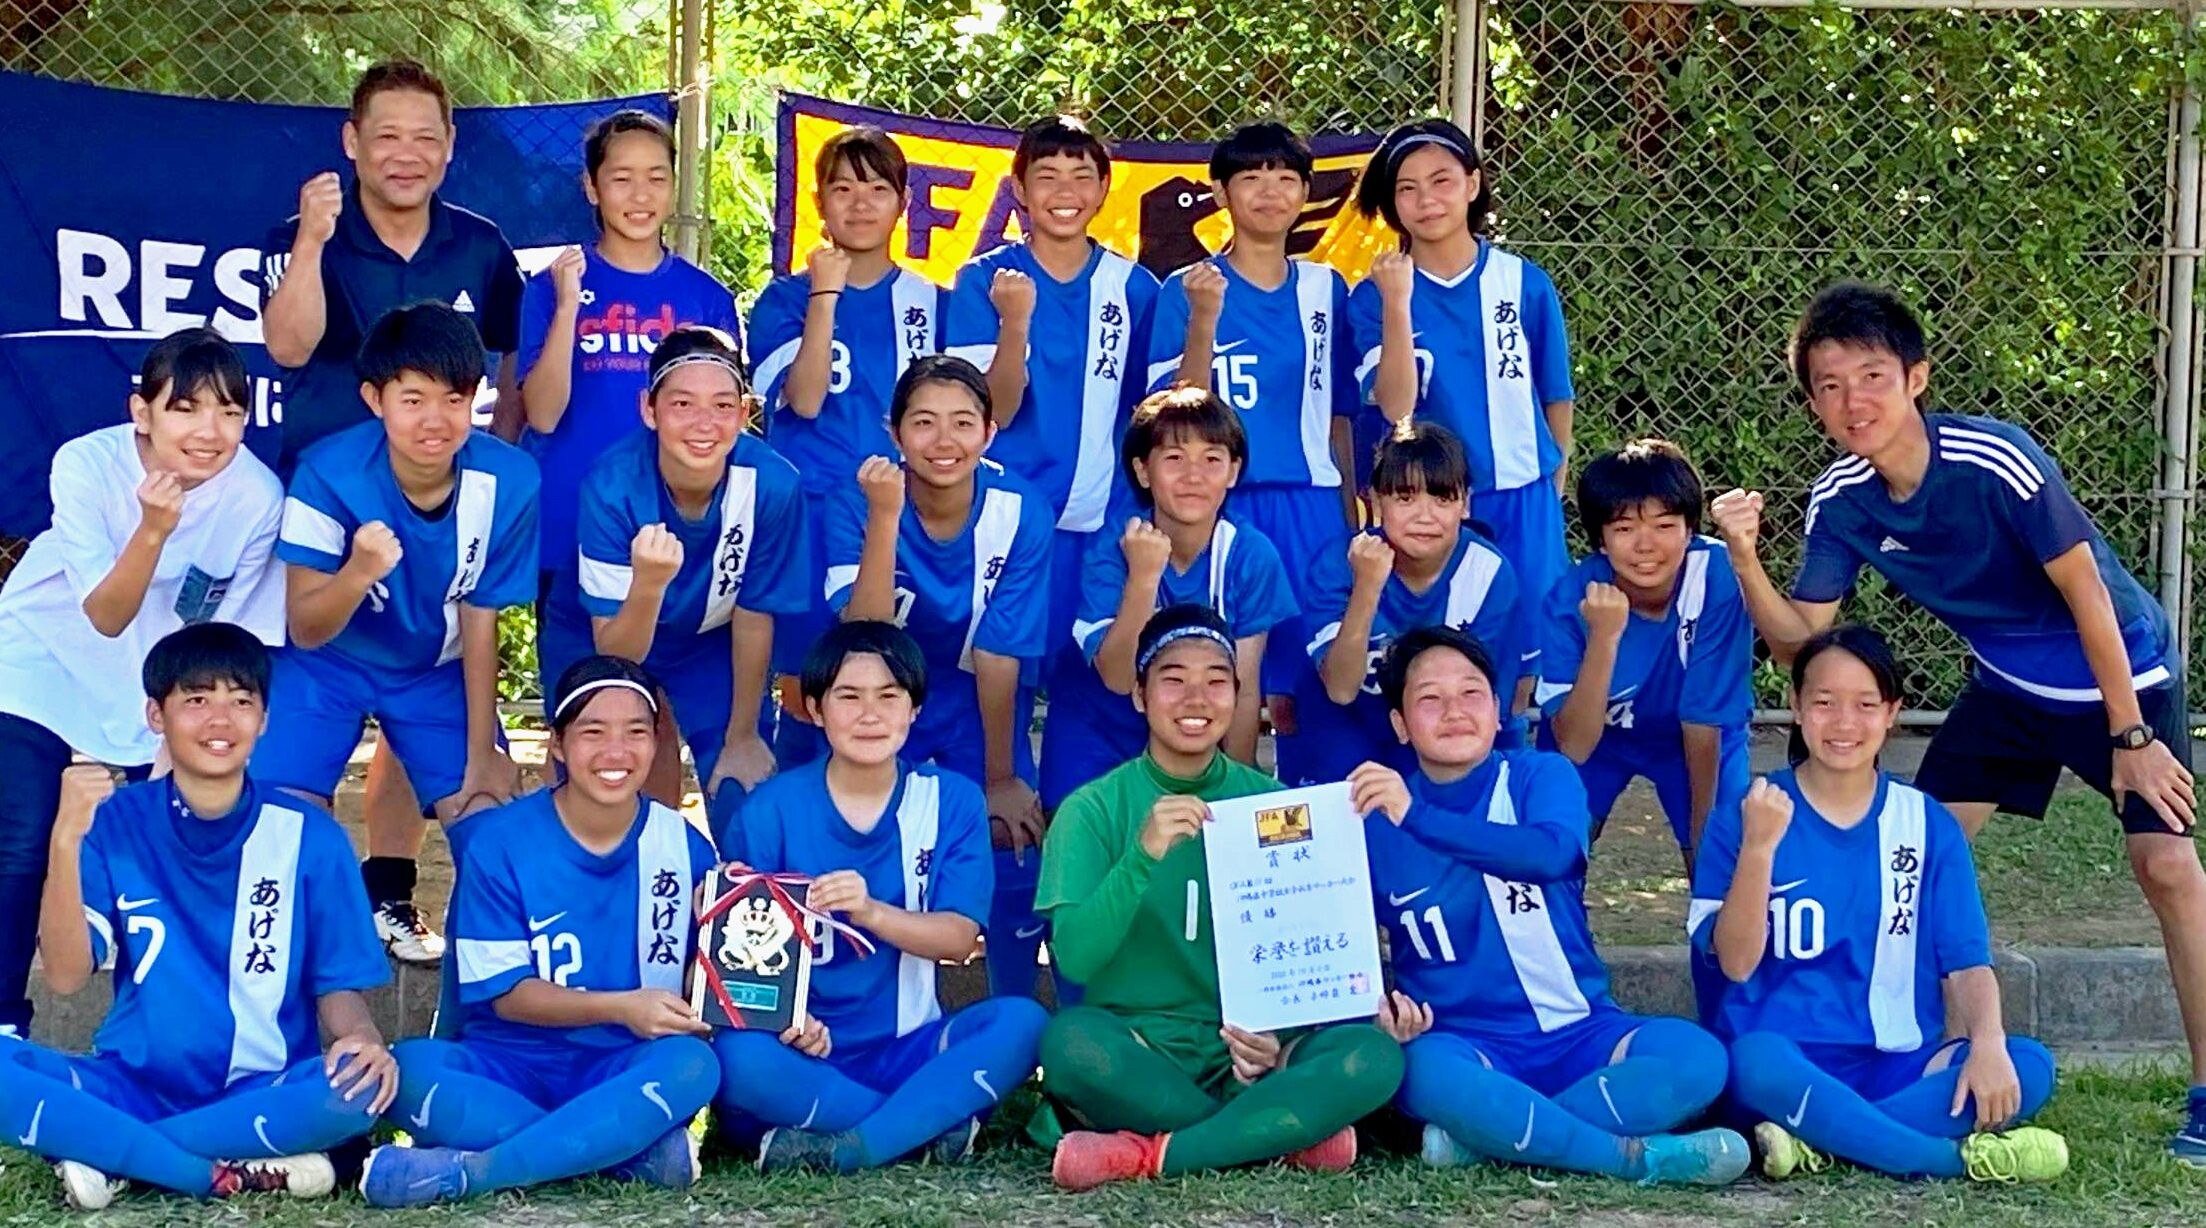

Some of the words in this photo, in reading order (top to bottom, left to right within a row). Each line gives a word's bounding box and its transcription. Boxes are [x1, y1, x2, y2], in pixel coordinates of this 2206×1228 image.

[579, 303, 695, 354] sfid
[903, 306, 929, 361] あげ
[1094, 301, 1123, 381] あげな
[1493, 300, 1524, 379] あげな
[1211, 354, 1258, 409] 15
[1259, 811, 1279, 823] JFA
[648, 868, 681, 965] あげな
[1185, 879, 1199, 941] 1
[1888, 844, 1920, 936] あげな
[127, 915, 166, 985] 7
[244, 876, 281, 974] あげな
[1400, 905, 1457, 962] 11
[1769, 897, 1825, 960] 10
[530, 932, 587, 992] 12
